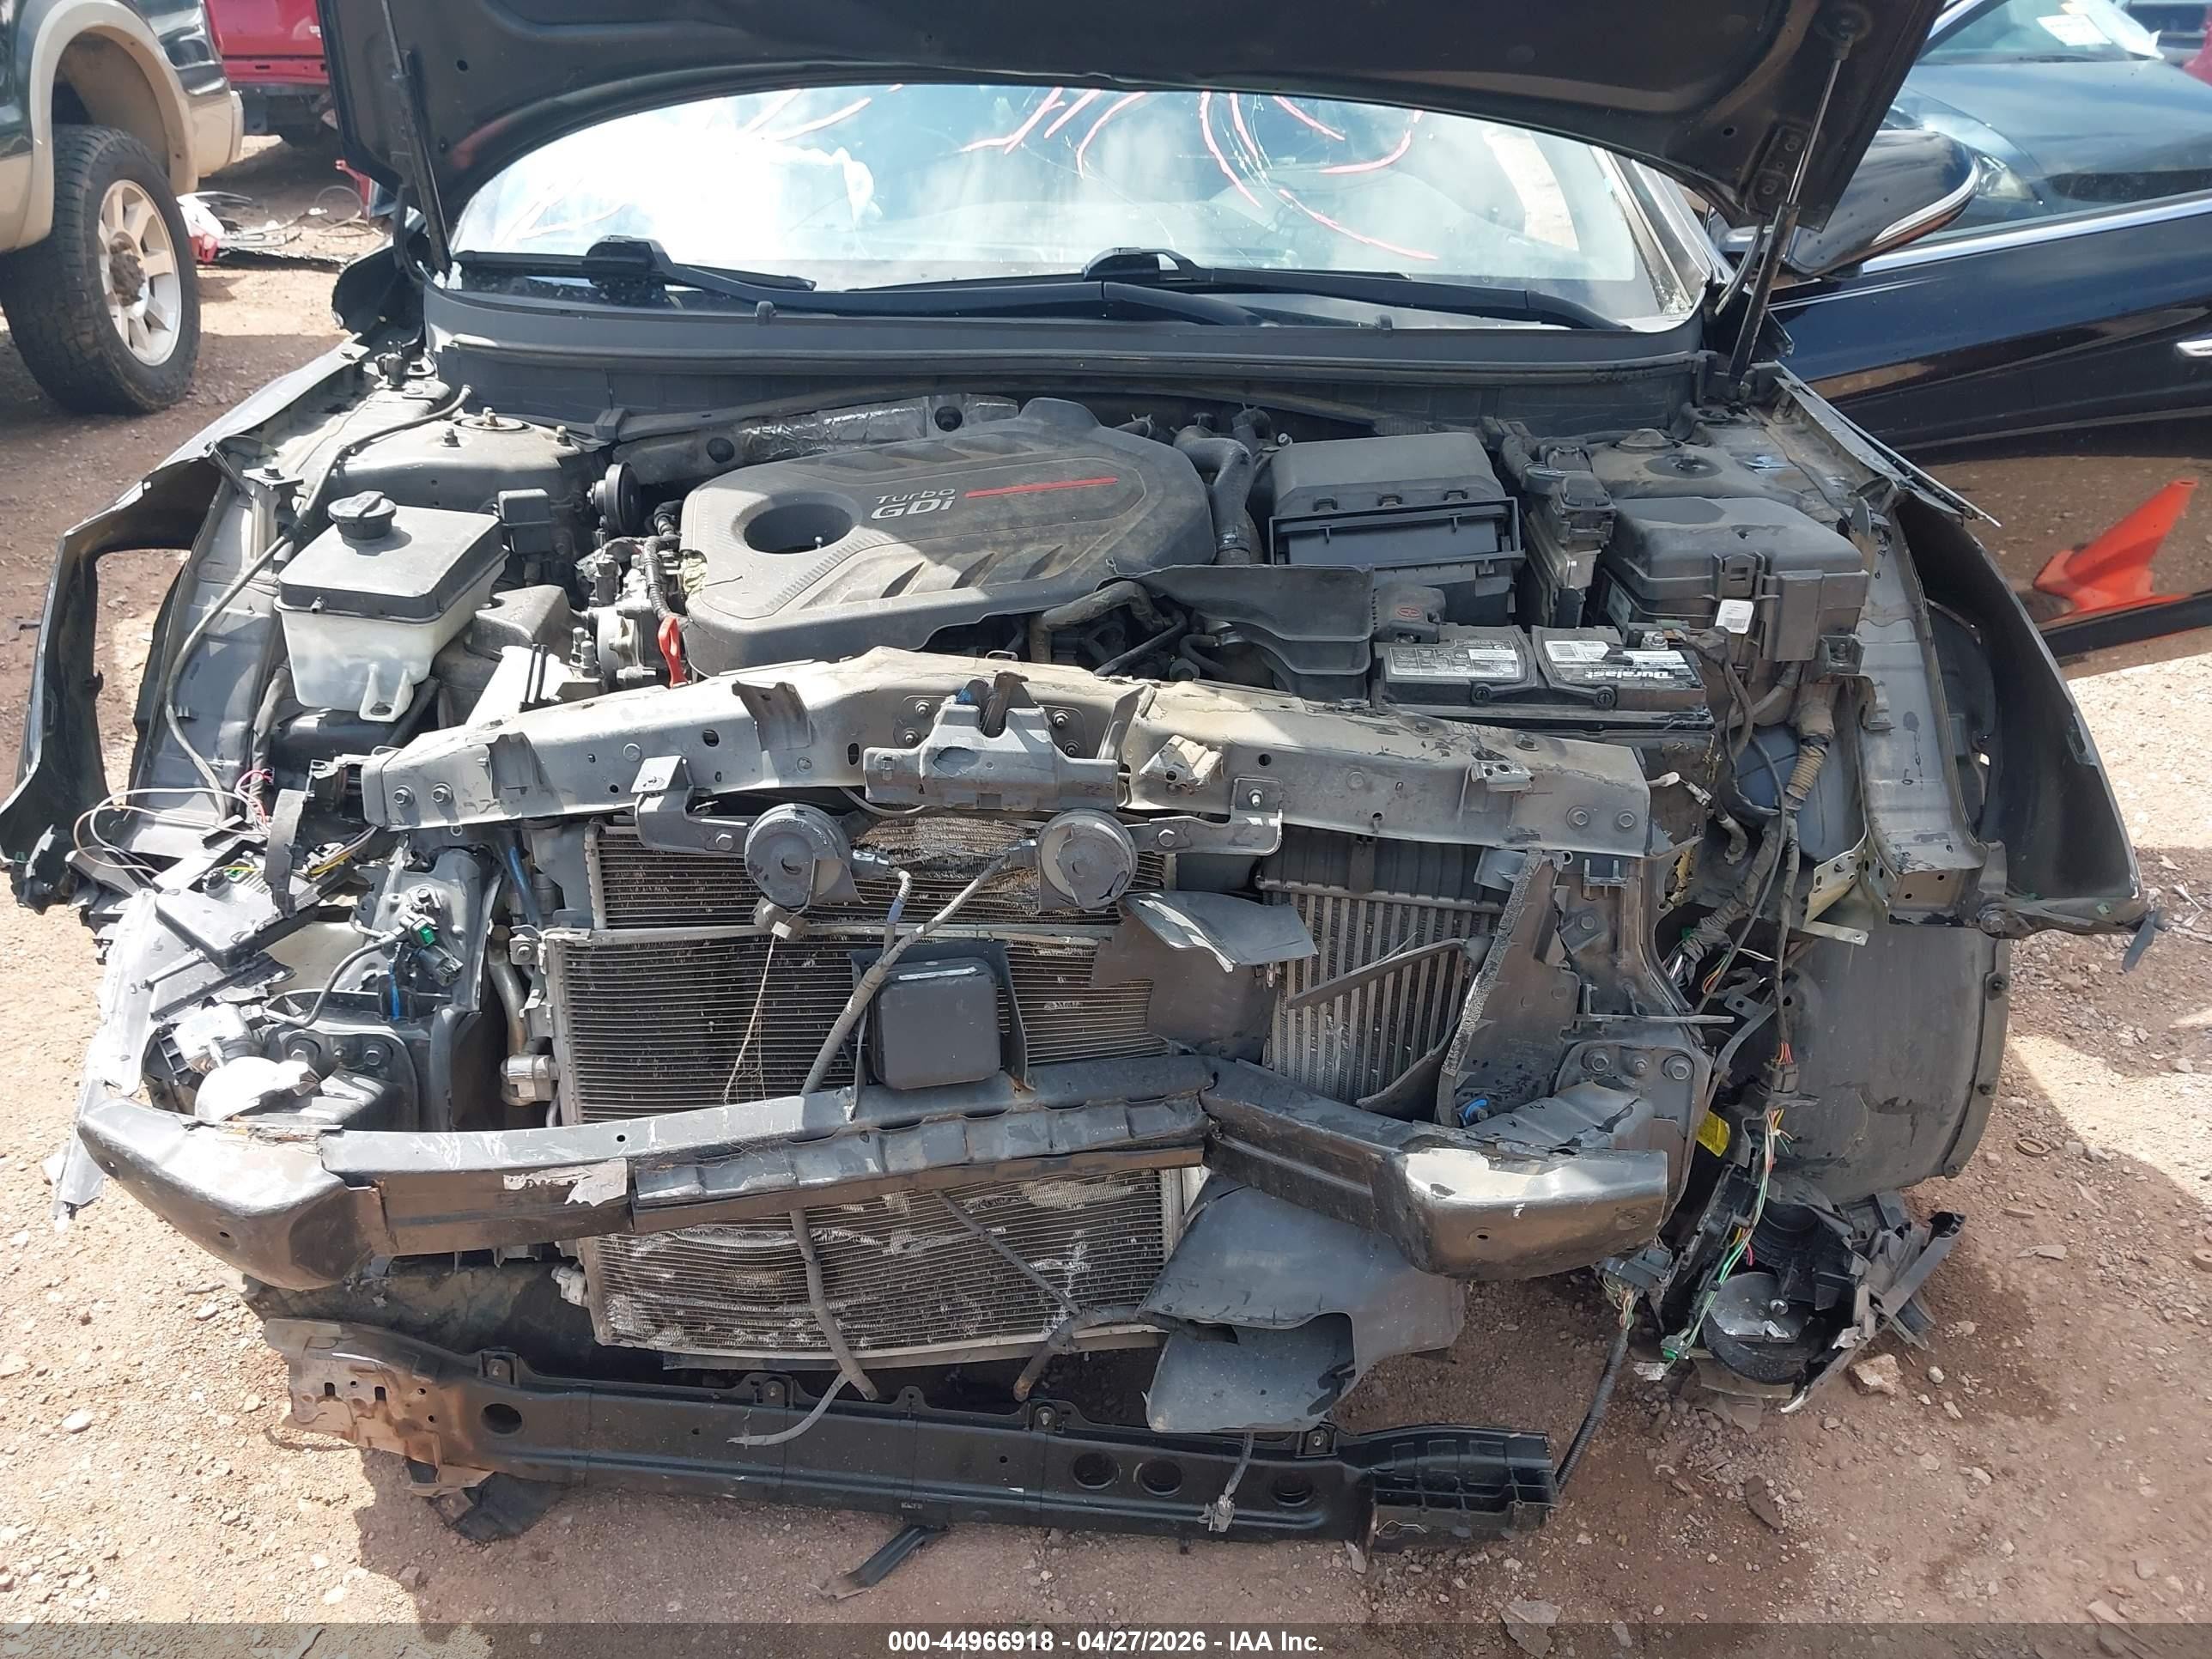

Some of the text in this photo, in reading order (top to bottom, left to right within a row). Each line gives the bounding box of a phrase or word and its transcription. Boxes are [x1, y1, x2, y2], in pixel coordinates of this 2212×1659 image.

[876, 488, 956, 504] Turbo
[871, 496, 956, 519] GDi
[1584, 671, 1674, 679] Duralast
